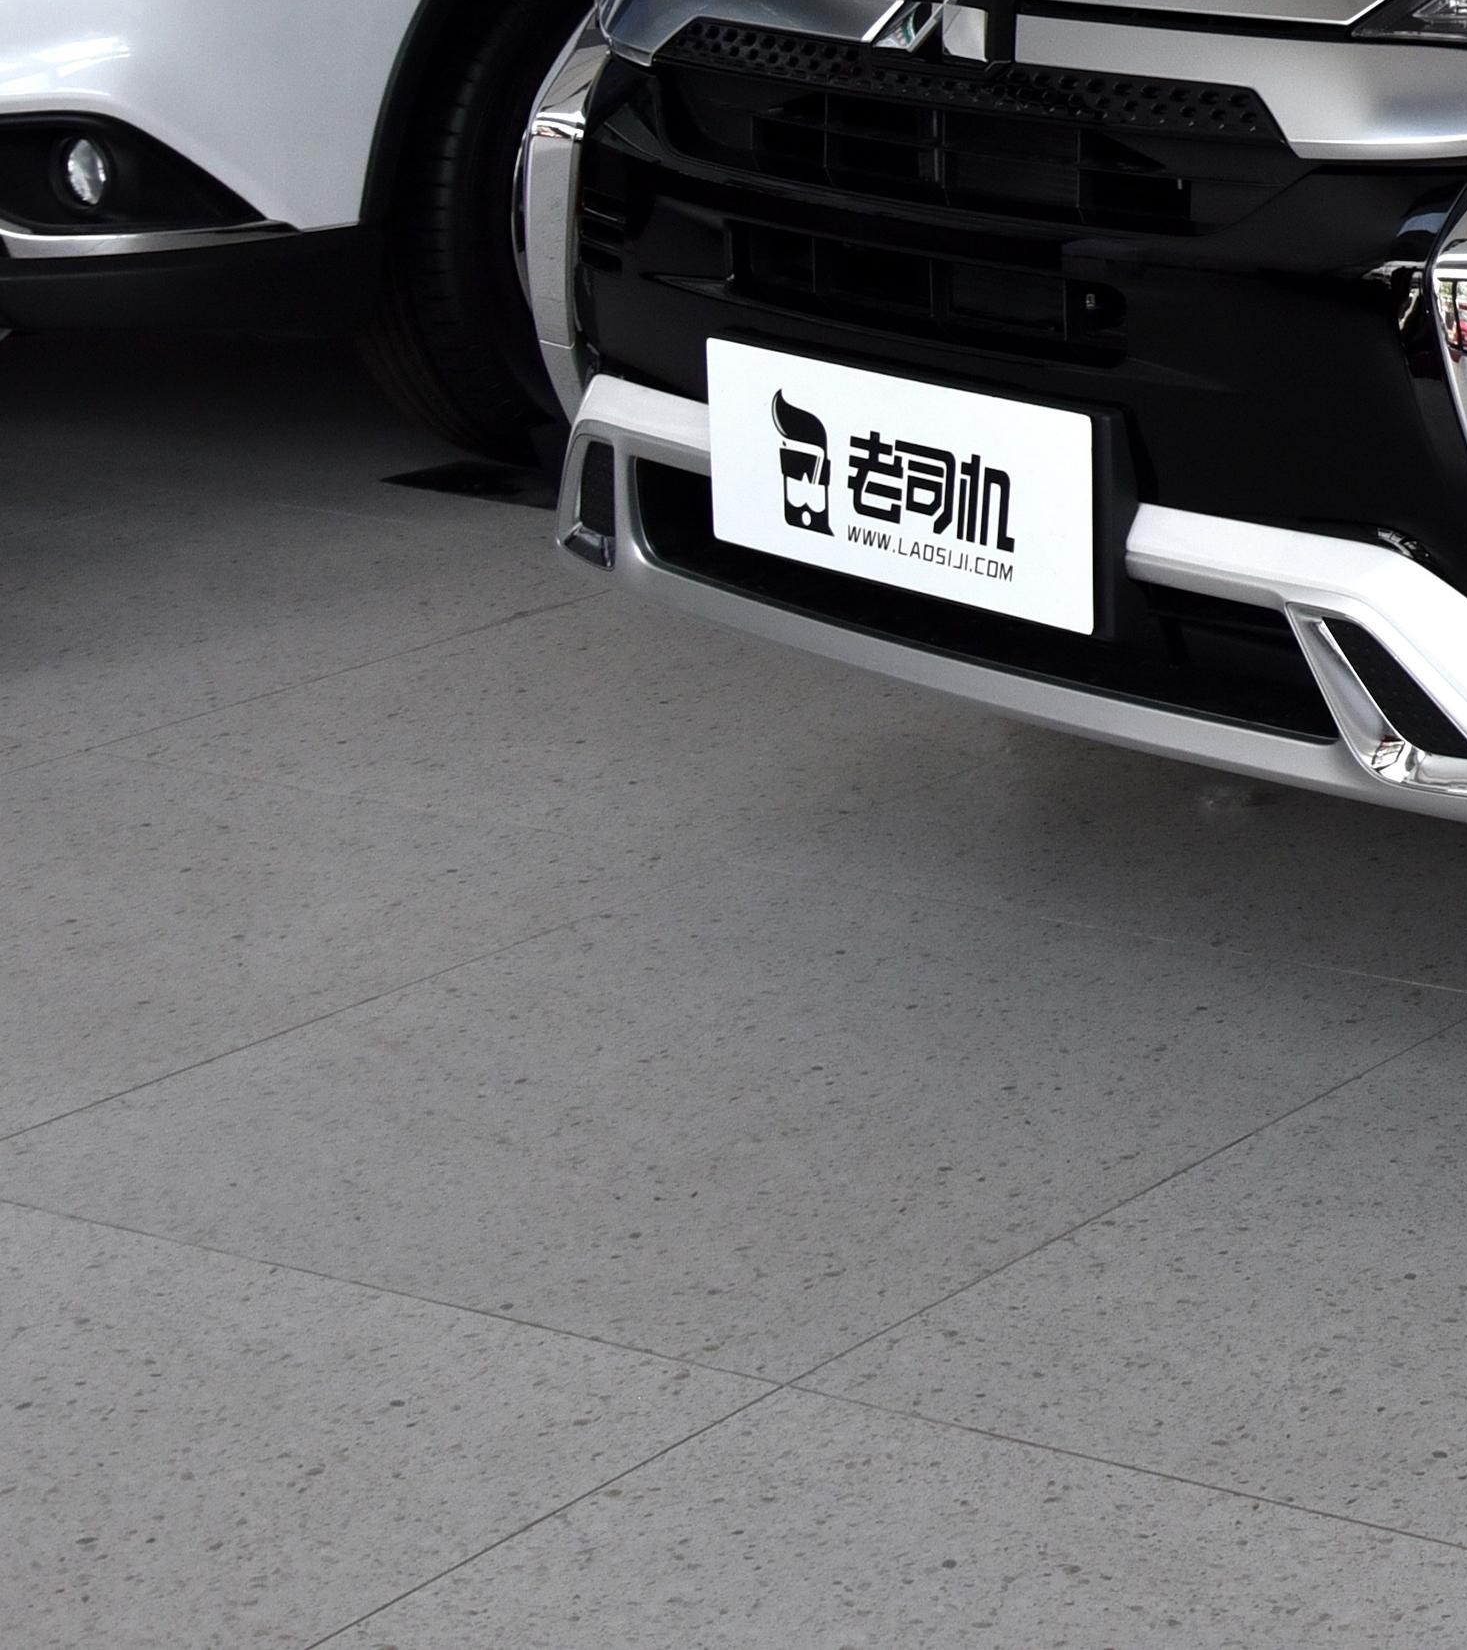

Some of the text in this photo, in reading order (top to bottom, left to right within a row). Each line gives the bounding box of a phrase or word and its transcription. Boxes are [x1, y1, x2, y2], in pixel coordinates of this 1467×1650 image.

[847, 431, 1015, 553] 老司机
[847, 524, 1015, 583] WWW.LAOSIJI.COM
